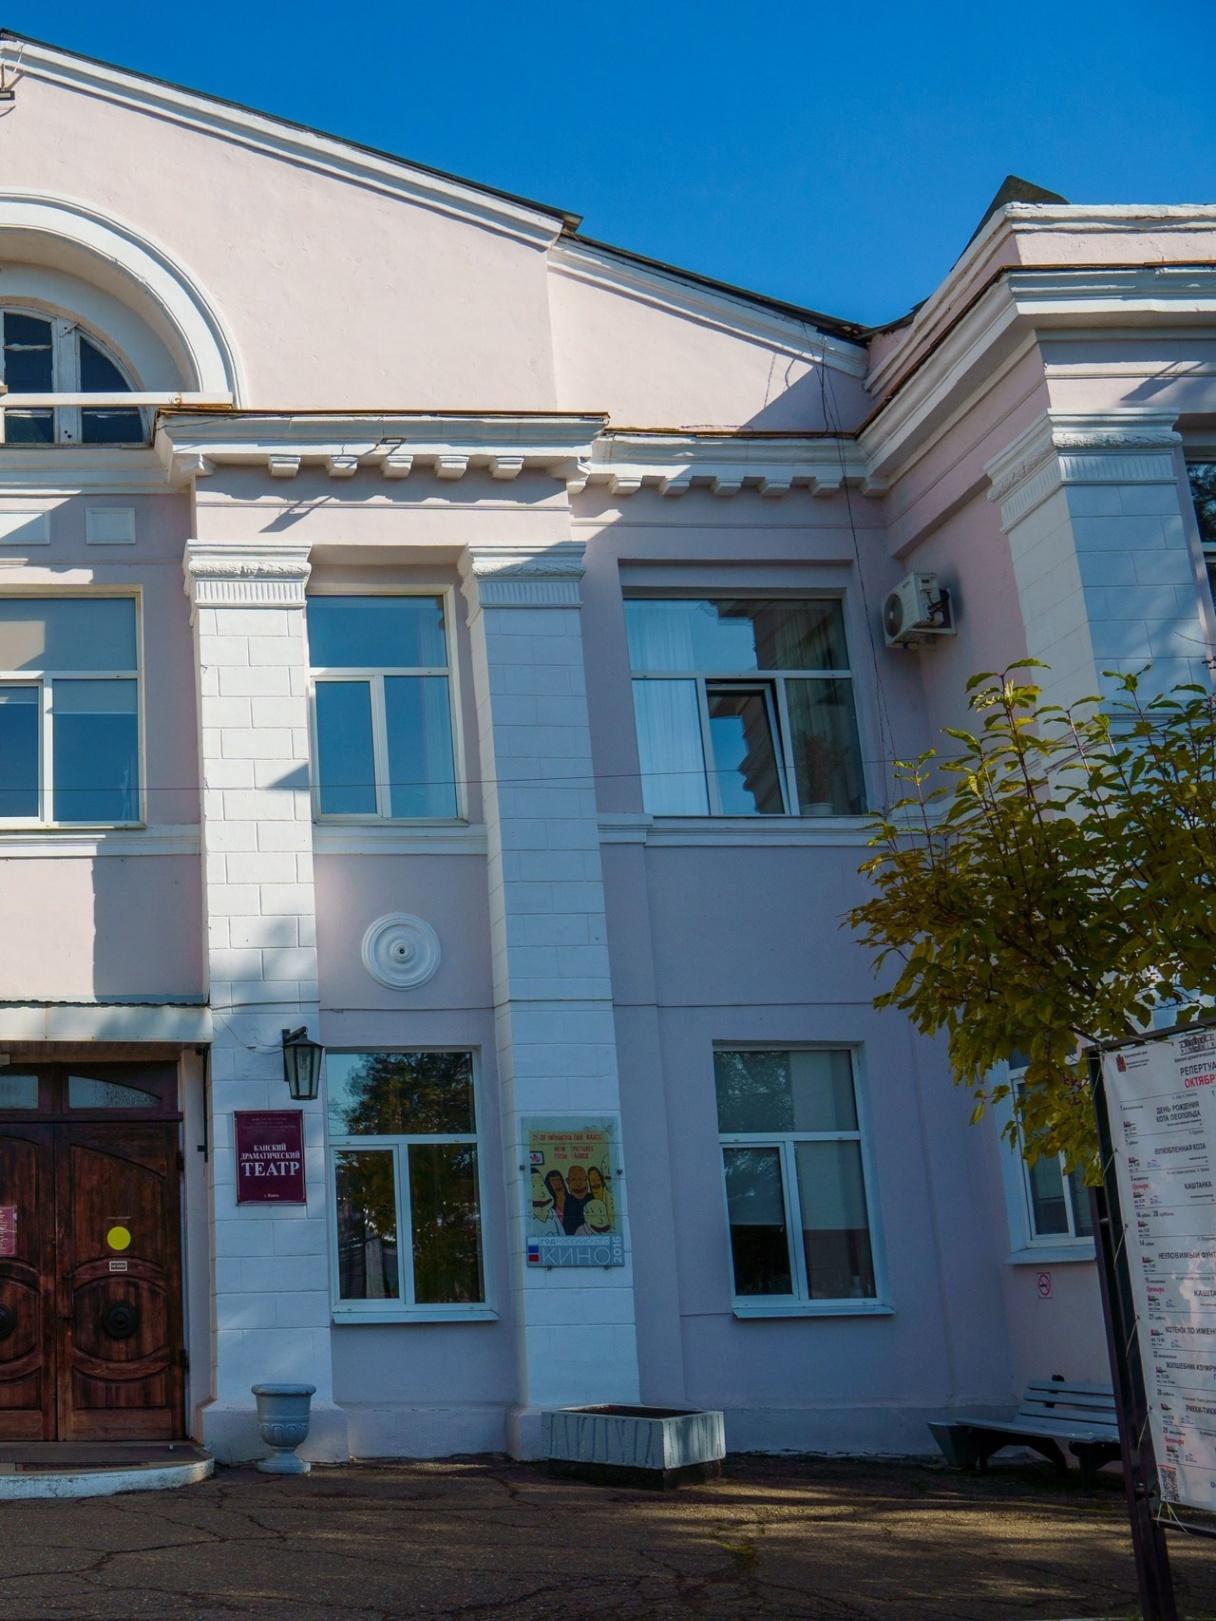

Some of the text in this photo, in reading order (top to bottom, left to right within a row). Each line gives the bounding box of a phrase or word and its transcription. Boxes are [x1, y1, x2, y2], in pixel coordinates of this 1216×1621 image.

[1180, 1062, 1216, 1076] РЕПЕРТУА
[1184, 1074, 1216, 1089] ОКТЯБР
[253, 1143, 287, 1151] КАНСКИЙ
[240, 1151, 300, 1160] ДРАМАТИЧЕСКИЙ
[241, 1161, 300, 1176] ТЕАТР
[1184, 1181, 1212, 1190] КАШТАНКА
[613, 1236, 623, 1264] 2016
[542, 1246, 611, 1265] КИНО
[1201, 1251, 1216, 1259] ФУНТ
[1194, 1289, 1216, 1297] КАШТА
[1196, 1327, 1216, 1335] ИМЕН
